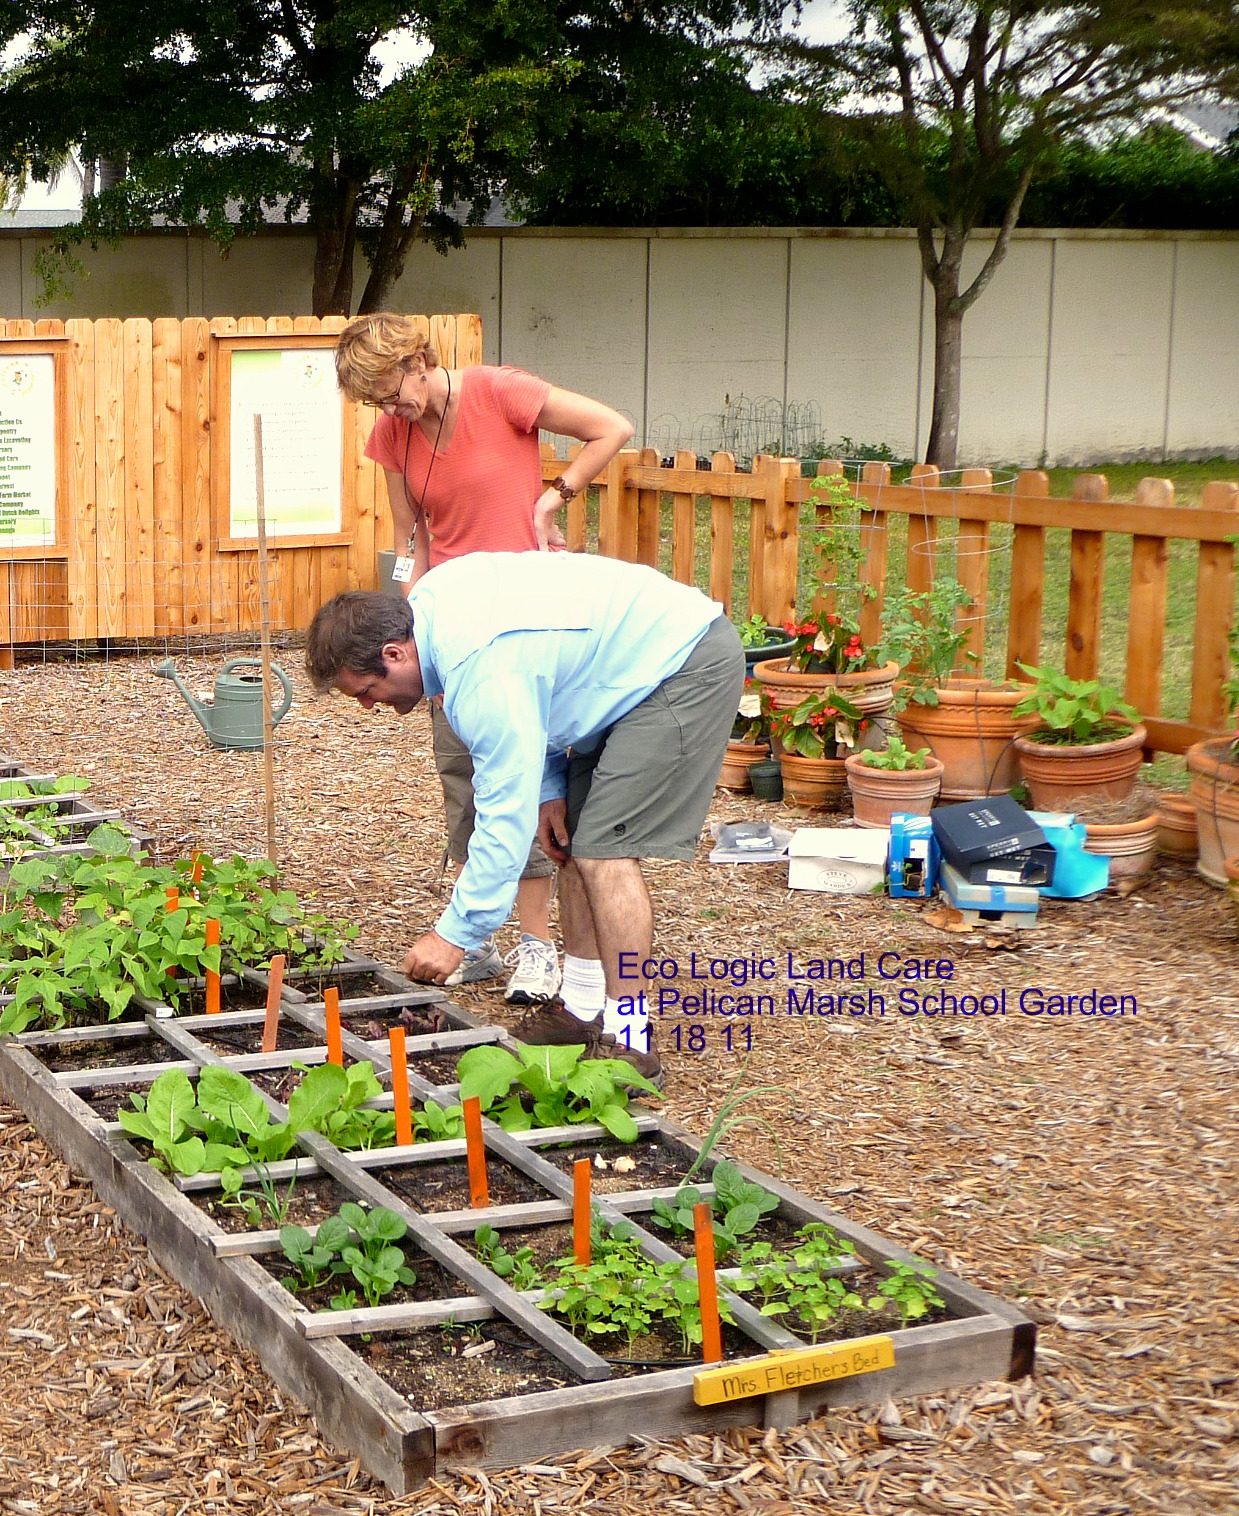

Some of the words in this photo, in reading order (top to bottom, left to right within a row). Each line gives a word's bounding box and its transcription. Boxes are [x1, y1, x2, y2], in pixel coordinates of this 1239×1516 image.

[3, 436, 31, 444] Excavating
[0, 491, 13, 499] Farm
[18, 508, 40, 516] Delights
[722, 1376, 761, 1398] Mrs.
[852, 1349, 880, 1372] Bed
